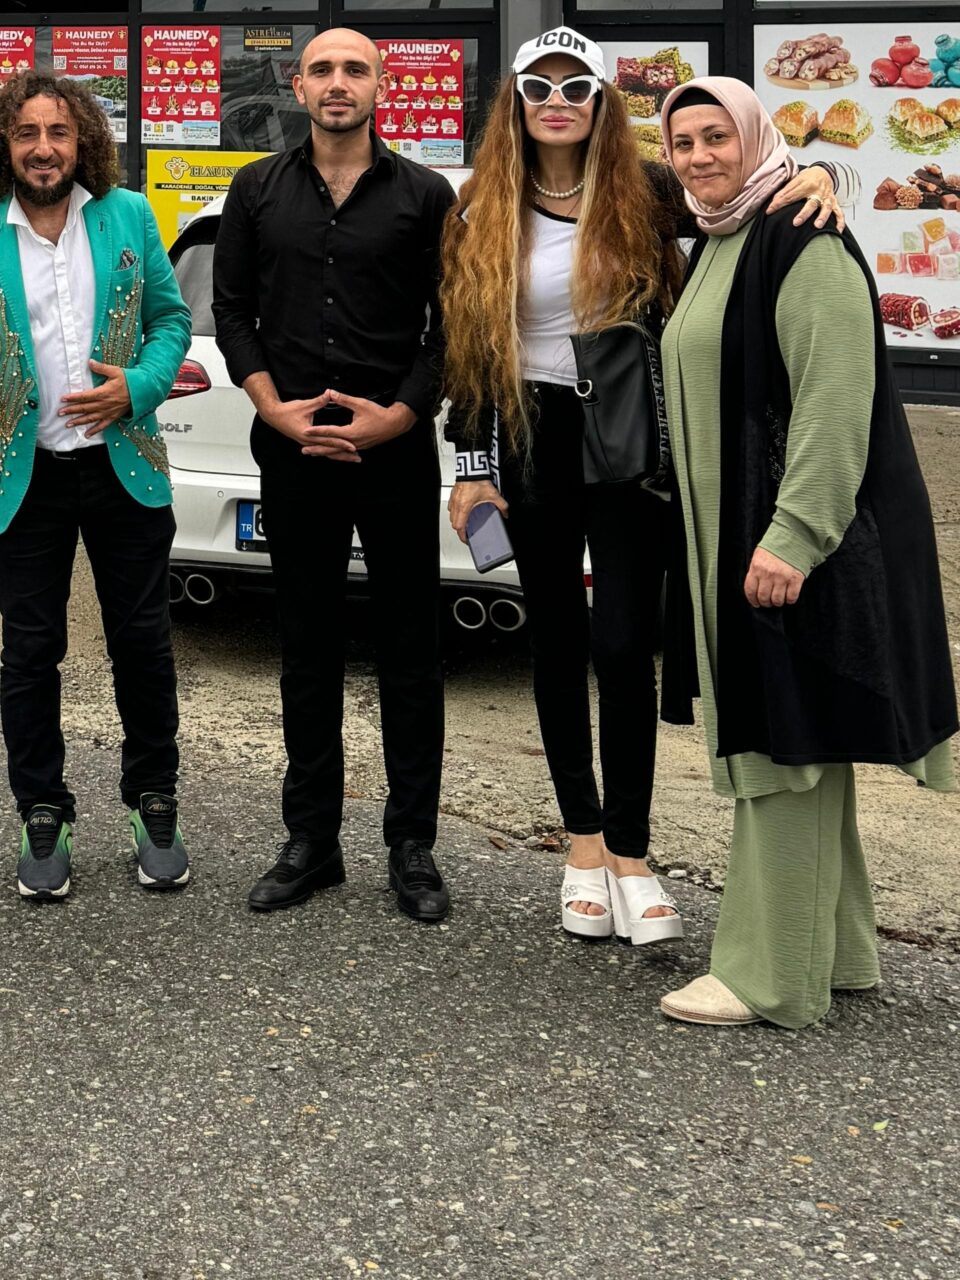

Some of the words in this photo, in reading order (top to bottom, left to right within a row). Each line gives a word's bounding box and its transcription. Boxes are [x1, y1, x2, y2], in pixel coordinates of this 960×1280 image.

[65, 31, 114, 39] HAUNEDY
[154, 30, 209, 40] HAUNEDY
[535, 32, 586, 53] ICON
[388, 44, 450, 54] HAUNEDY
[189, 165, 240, 177] HAUN
[240, 523, 253, 533] TR
